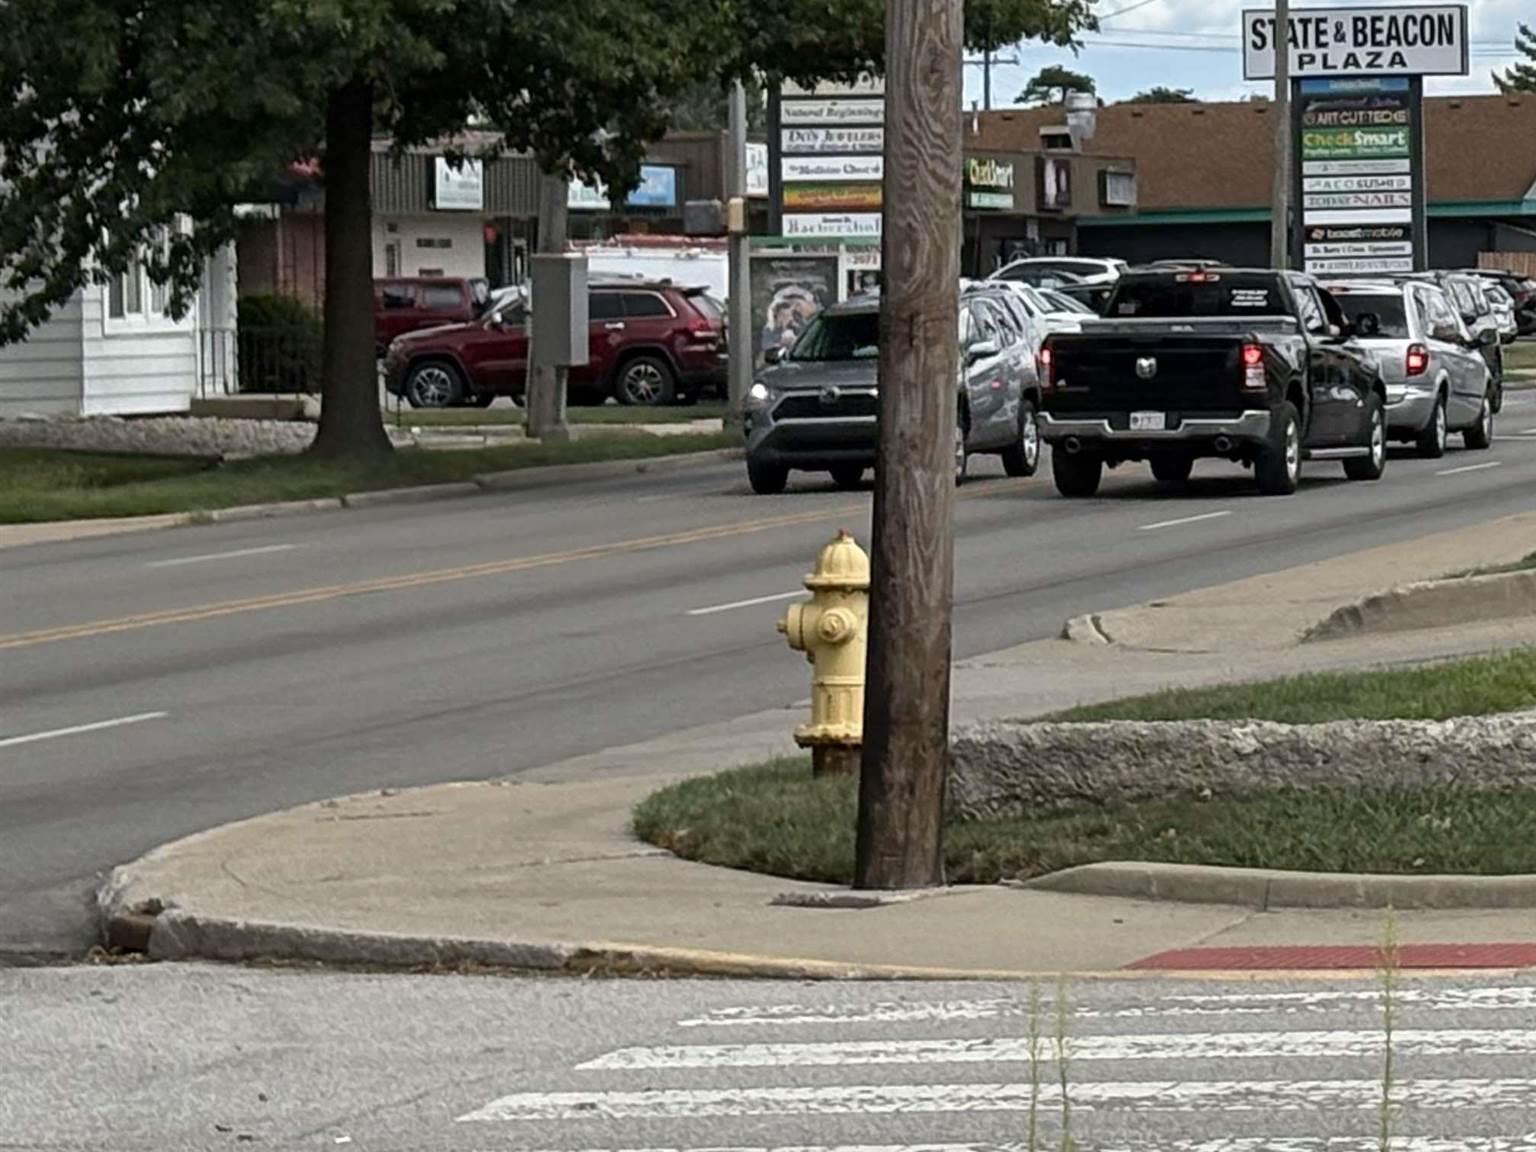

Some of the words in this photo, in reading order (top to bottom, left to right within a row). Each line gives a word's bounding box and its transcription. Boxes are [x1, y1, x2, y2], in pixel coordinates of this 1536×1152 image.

[1333, 20, 1346, 44] &
[1352, 13, 1454, 48] BEACON
[1298, 51, 1408, 71] PLAZA
[1303, 130, 1406, 147] CheckSmart
